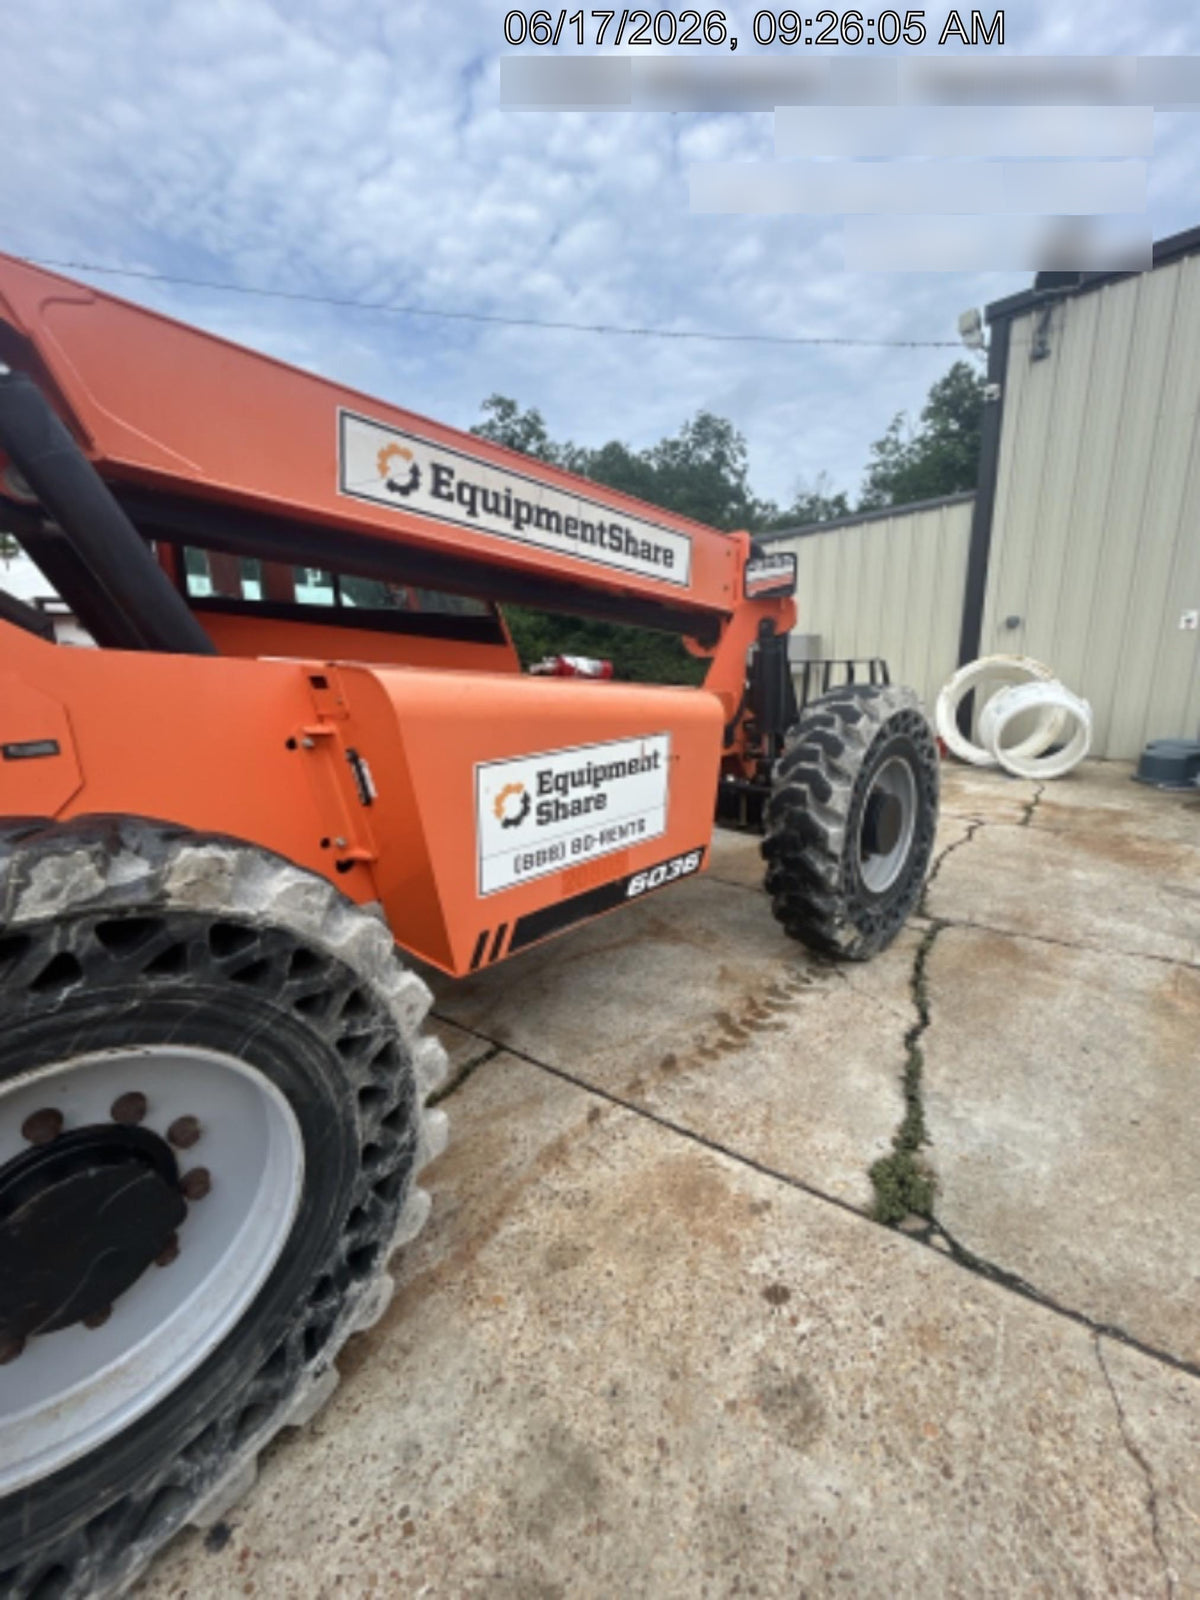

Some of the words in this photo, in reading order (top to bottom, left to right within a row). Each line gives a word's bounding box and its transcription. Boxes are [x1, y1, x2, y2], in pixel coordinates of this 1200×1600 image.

[430, 462, 675, 568] EquipmentShare
[536, 750, 660, 796] Equipment
[536, 793, 607, 826] Share
[513, 842, 566, 874] (888)
